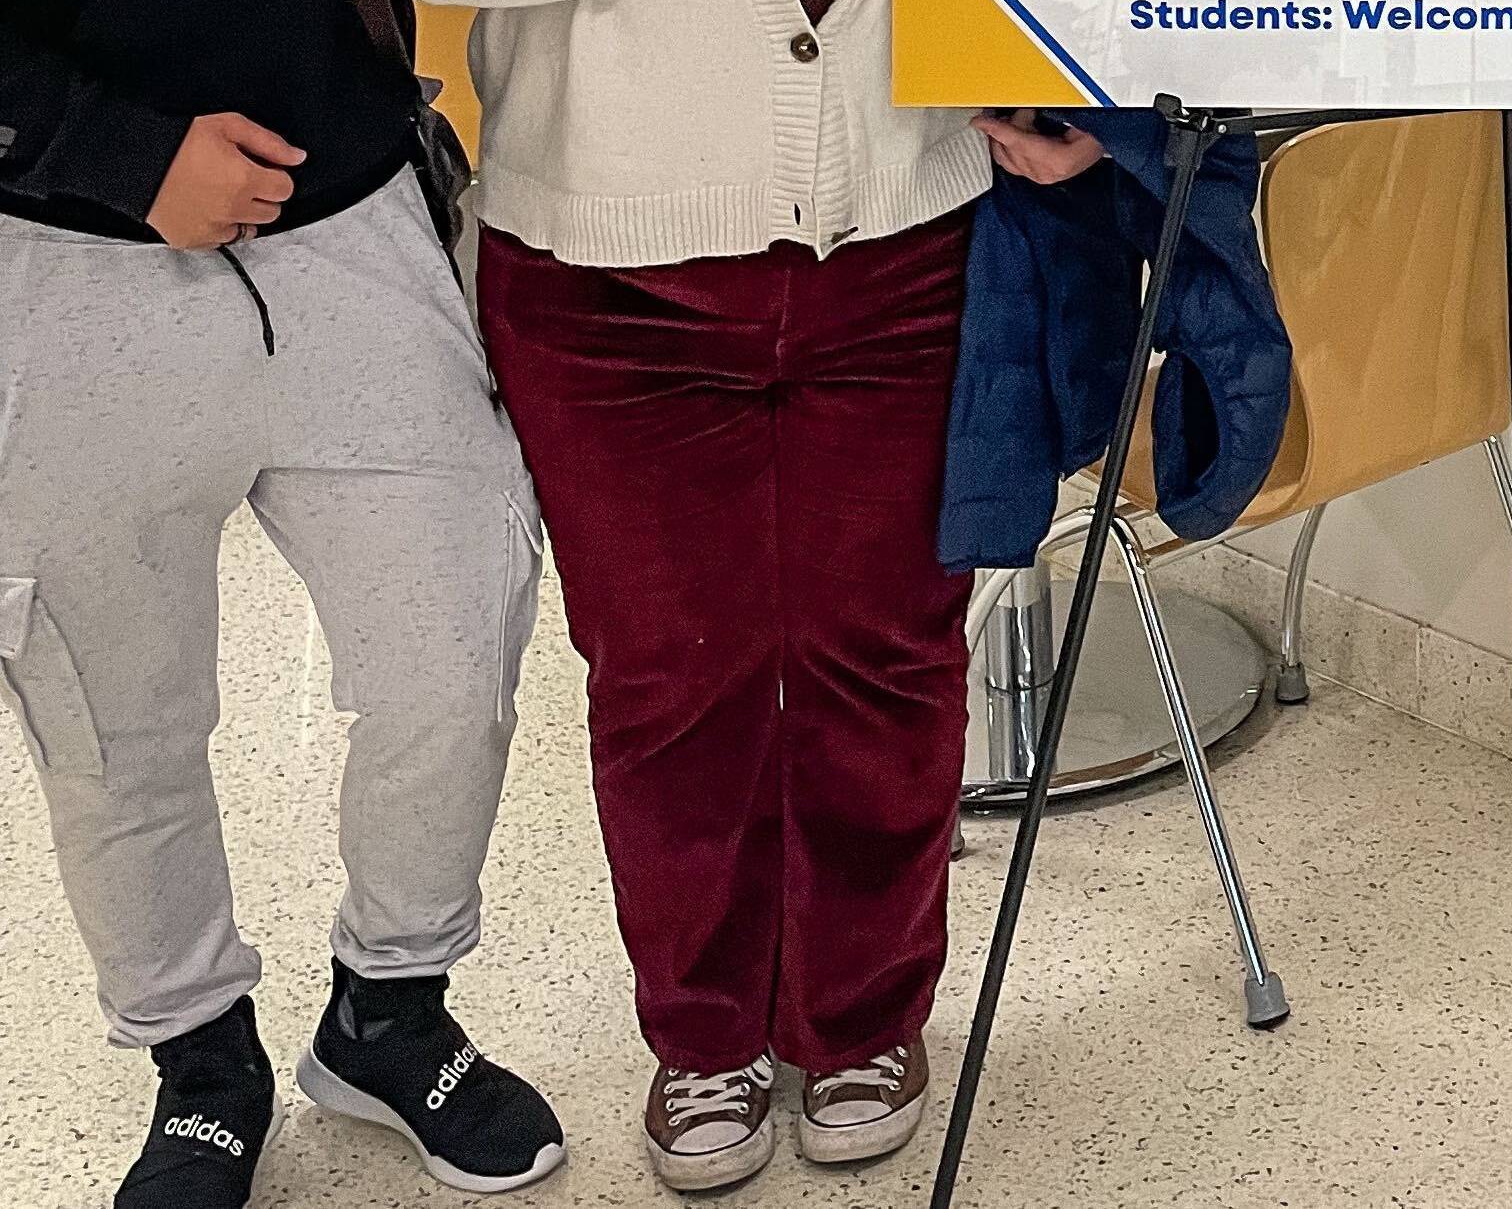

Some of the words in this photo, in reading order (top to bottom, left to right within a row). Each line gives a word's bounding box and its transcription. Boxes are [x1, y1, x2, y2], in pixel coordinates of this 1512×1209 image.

[1130, 0, 1332, 30] Students:
[425, 1041, 480, 1110] adidas
[164, 1113, 246, 1157] adidas
